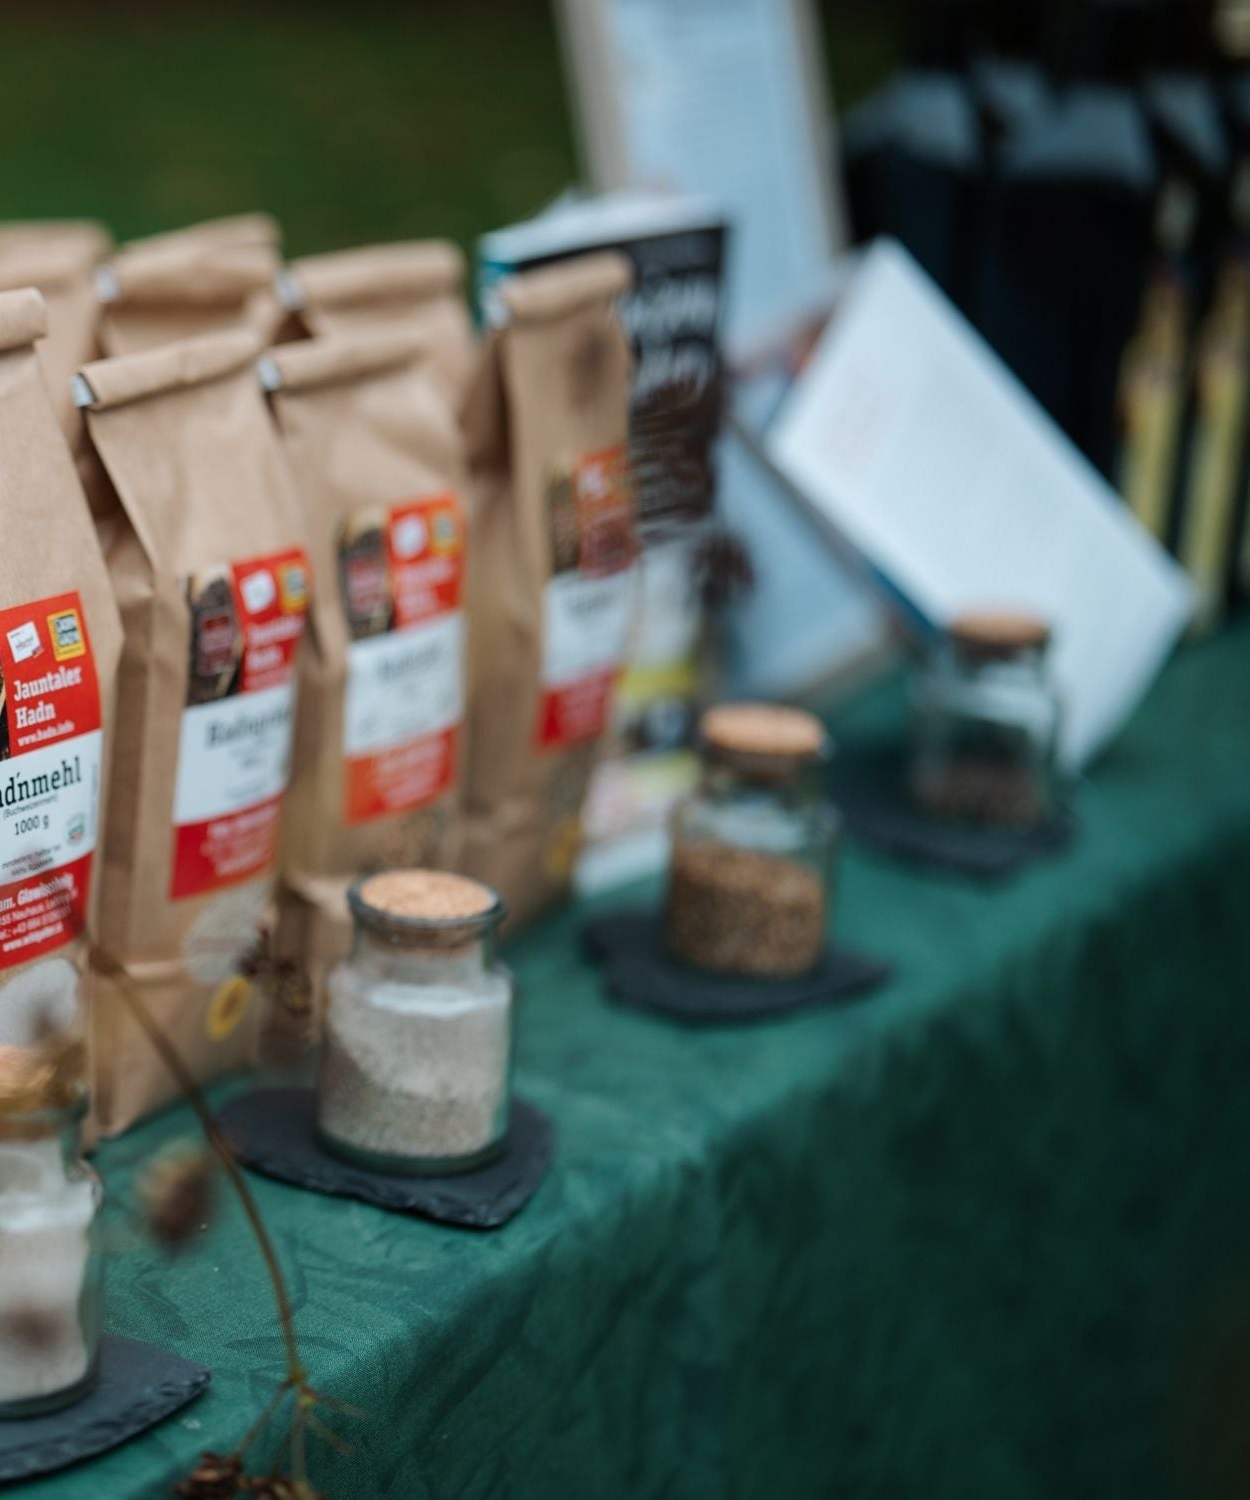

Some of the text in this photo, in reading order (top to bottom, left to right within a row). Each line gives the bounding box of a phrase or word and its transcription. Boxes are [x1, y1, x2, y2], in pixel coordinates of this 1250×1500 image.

[14, 665, 82, 701] Jauntaler
[15, 701, 56, 729] Hadn
[14, 815, 40, 835] 1000
[43, 814, 49, 830] g
